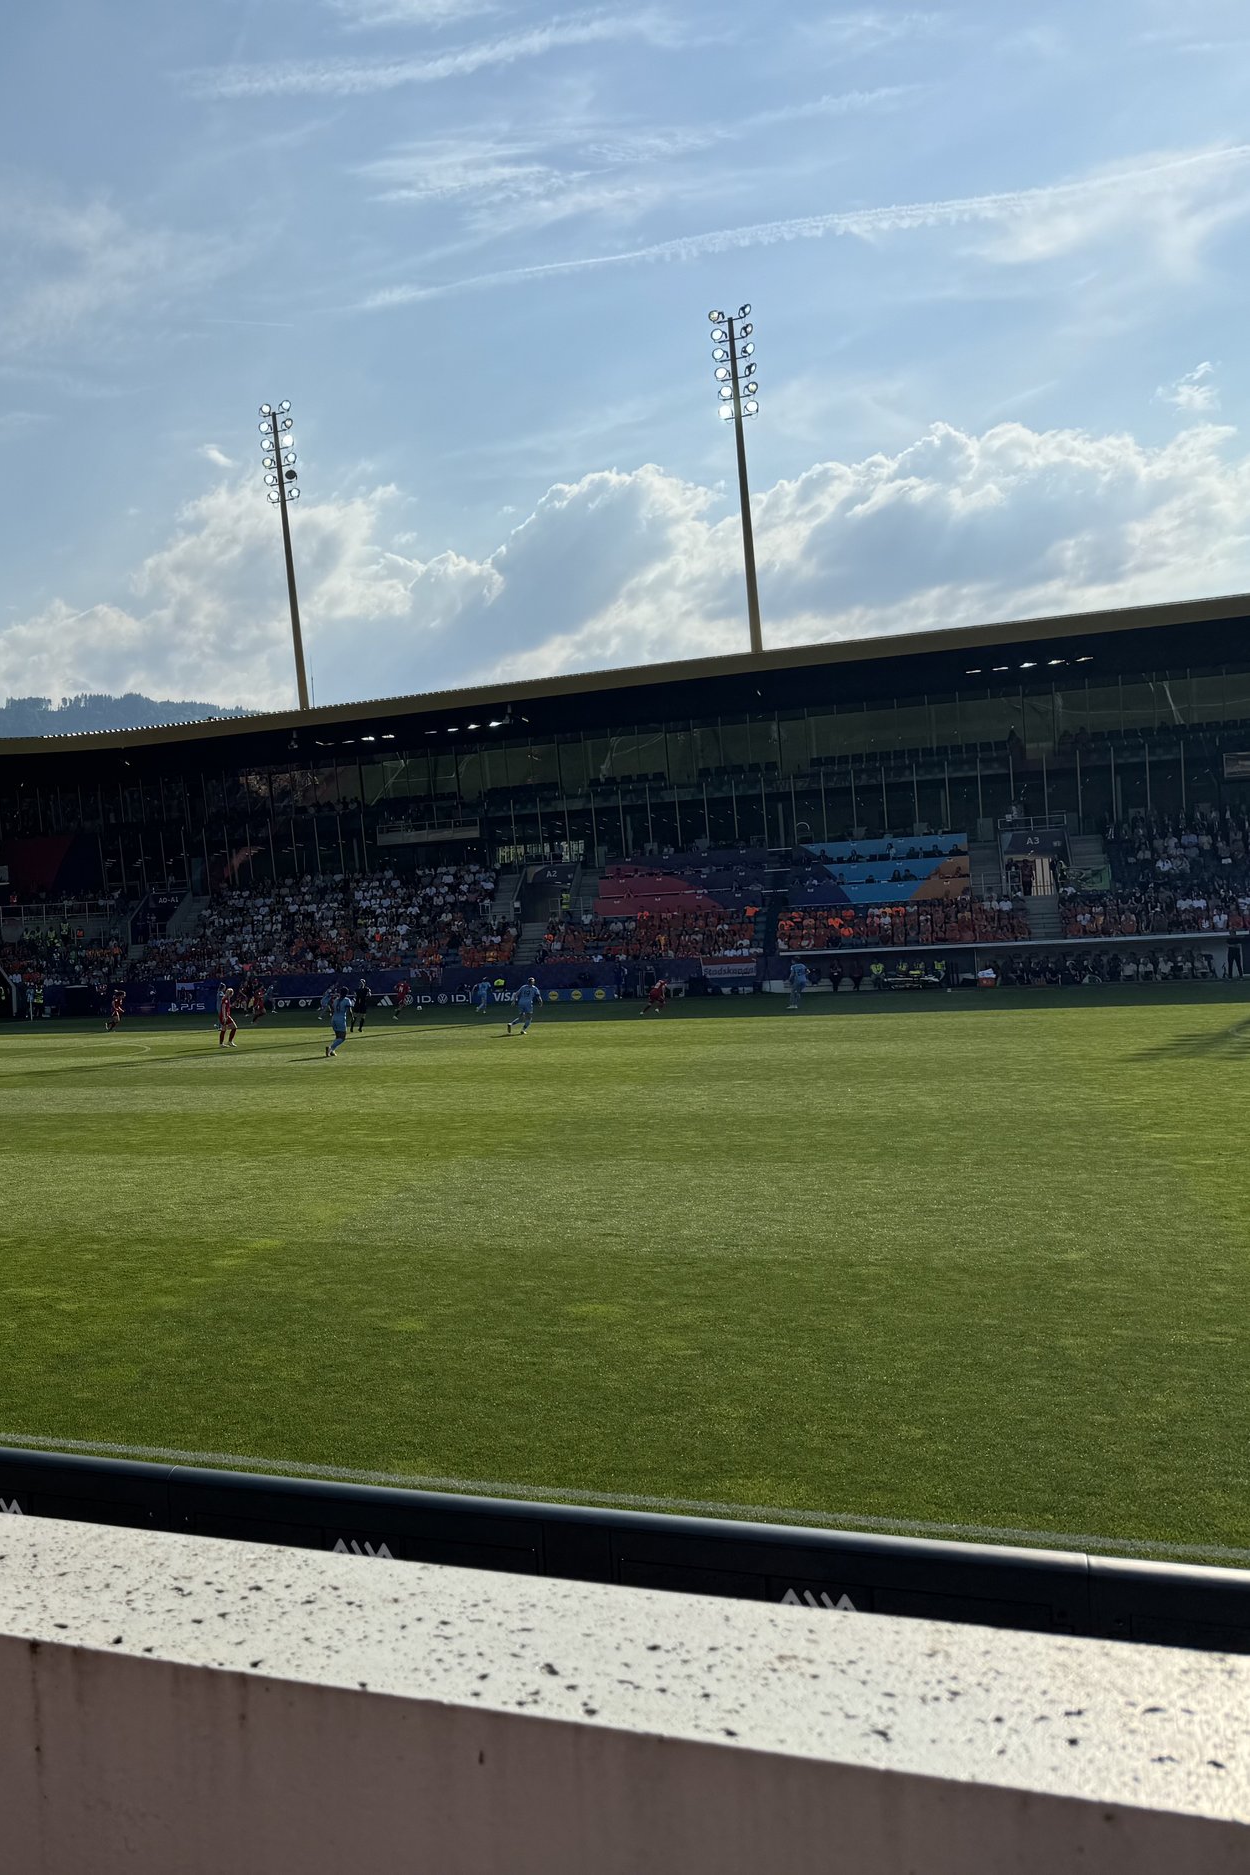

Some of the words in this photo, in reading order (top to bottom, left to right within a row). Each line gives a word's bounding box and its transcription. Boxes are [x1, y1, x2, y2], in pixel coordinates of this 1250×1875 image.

[1026, 836, 1040, 845] A3
[546, 870, 558, 878] A2
[416, 995, 434, 1004] ID.
[451, 994, 469, 1003] ID.
[180, 1002, 206, 1011] PS5
